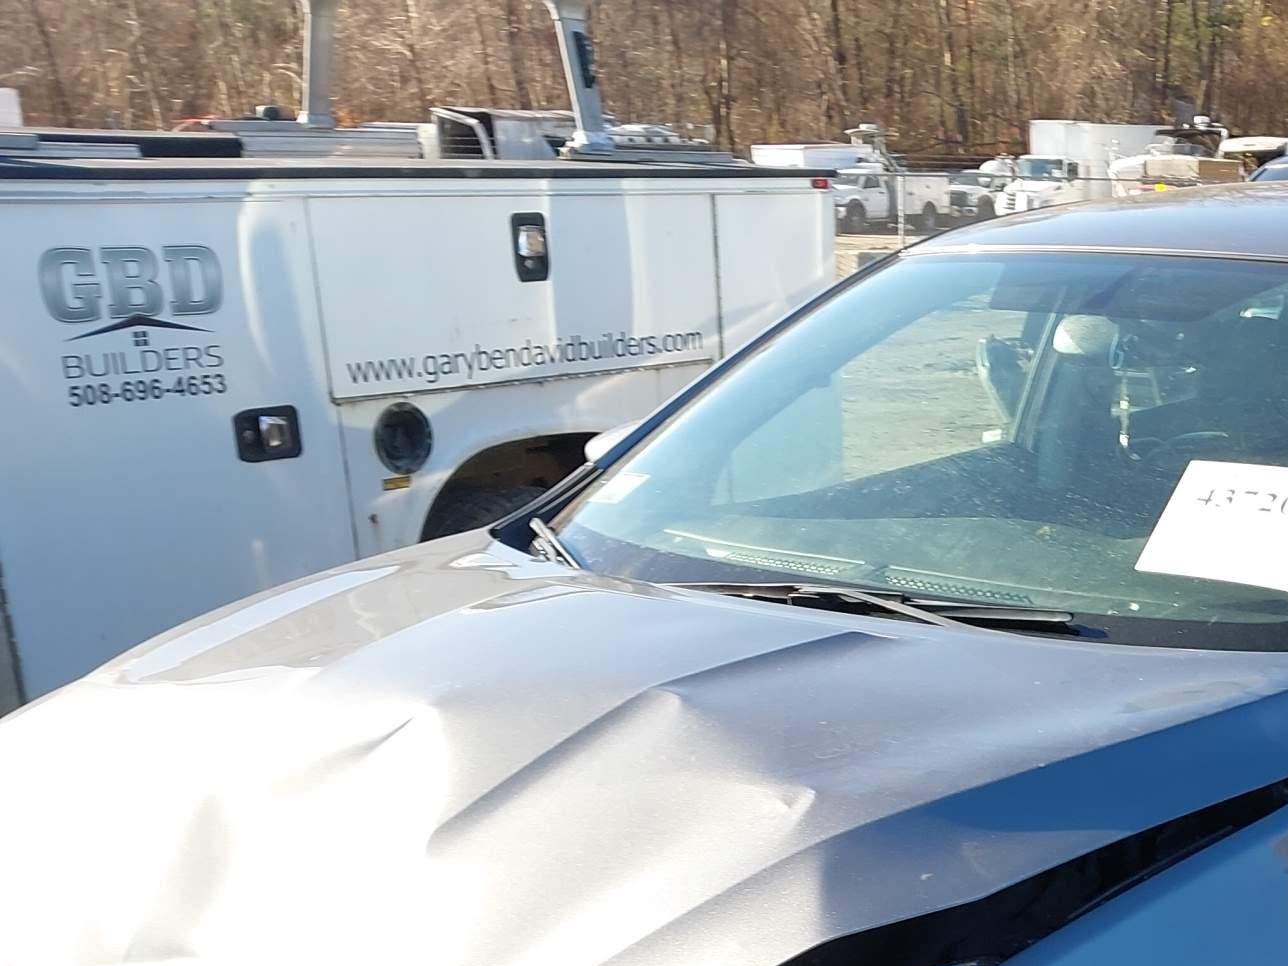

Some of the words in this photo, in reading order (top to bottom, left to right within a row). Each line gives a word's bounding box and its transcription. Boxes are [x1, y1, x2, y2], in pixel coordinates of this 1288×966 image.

[38, 245, 224, 323] GBD
[61, 345, 224, 379] BUILDERS
[346, 330, 704, 384] www.garybendavidbuilders.com
[68, 373, 228, 407] 508-696-4653
